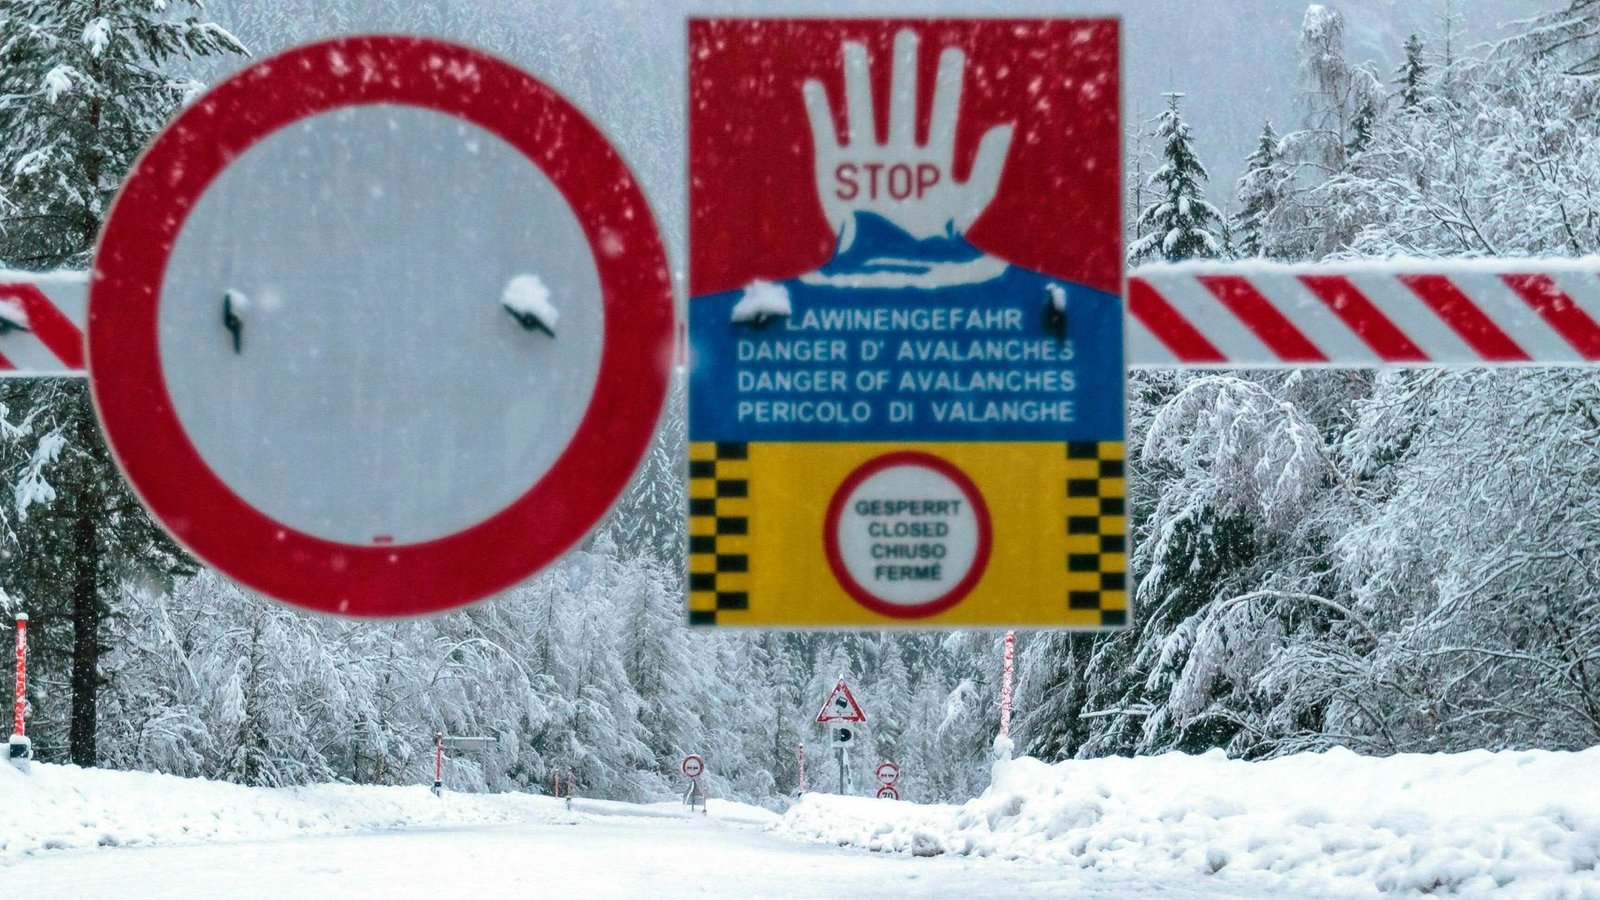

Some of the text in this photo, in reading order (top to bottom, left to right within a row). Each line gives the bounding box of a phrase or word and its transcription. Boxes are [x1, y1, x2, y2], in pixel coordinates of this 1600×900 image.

[835, 162, 941, 200] STOP
[786, 308, 1022, 330] LAWINENGEFAHR
[738, 339, 1074, 361] DANGER D' AVALANCHES
[738, 370, 1076, 392] DANGER OF AVALANCHES
[738, 401, 1074, 422] PERICOLO DI VALANGHE
[855, 500, 961, 516] GESPERRT
[868, 522, 949, 537] CLOSED
[871, 543, 947, 559] CHIUSO
[875, 562, 942, 581] FERMÉ
